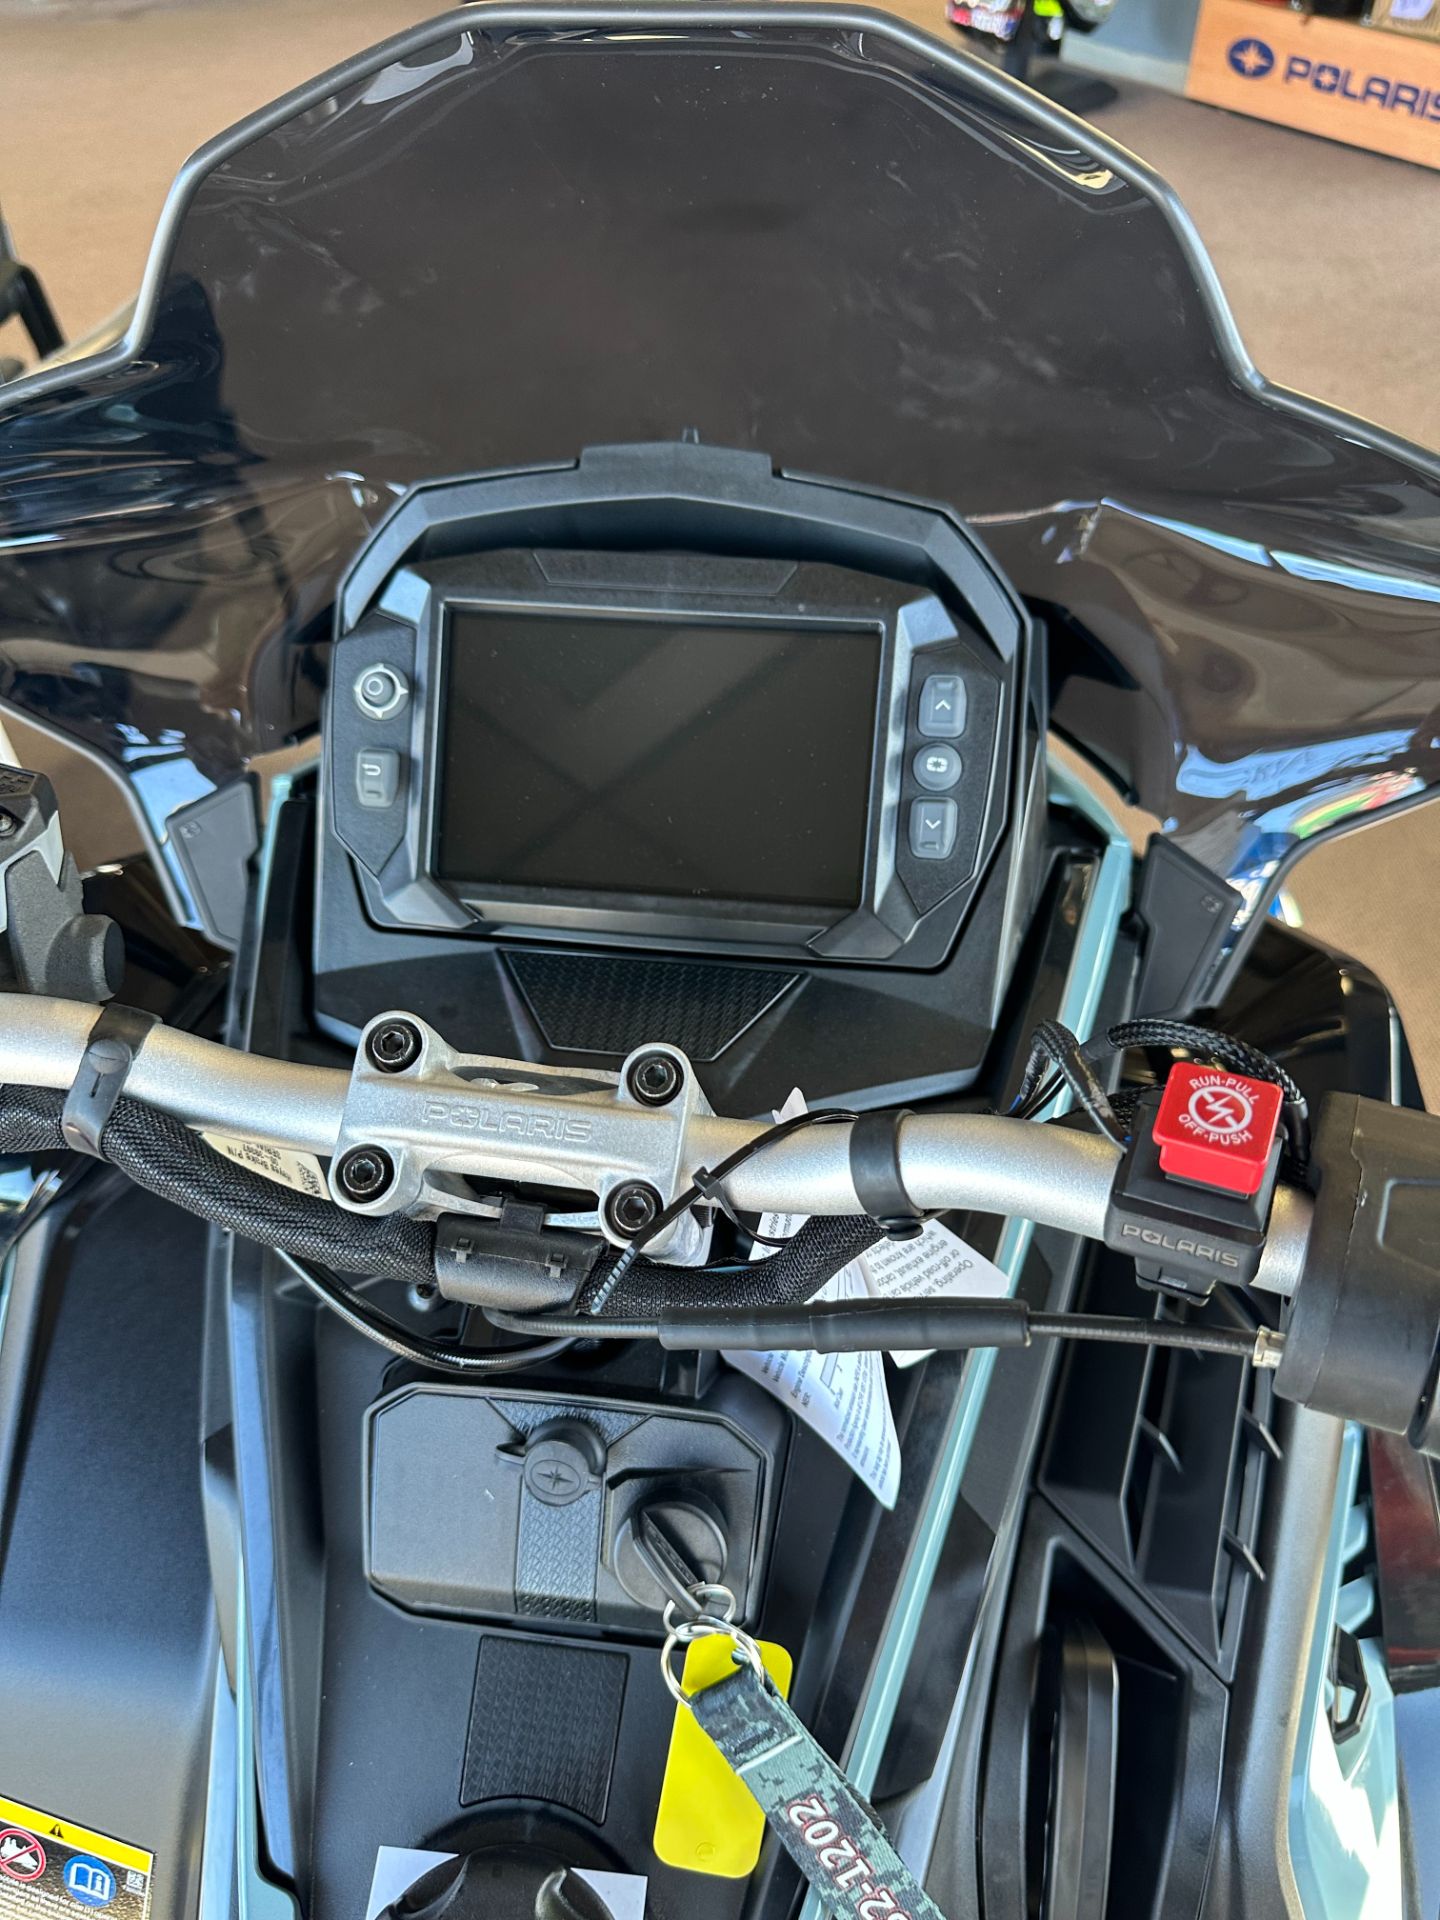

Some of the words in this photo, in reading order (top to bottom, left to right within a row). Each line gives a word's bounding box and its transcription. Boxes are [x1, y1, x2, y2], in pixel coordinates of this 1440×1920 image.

[1188, 1075, 1261, 1105] RUN-PULL
[419, 1099, 593, 1143] POLARIS
[1178, 1113, 1254, 1146] OFF-PUSH
[1122, 1223, 1239, 1268] POLARIS
[899, 1273, 925, 1293] vehicle
